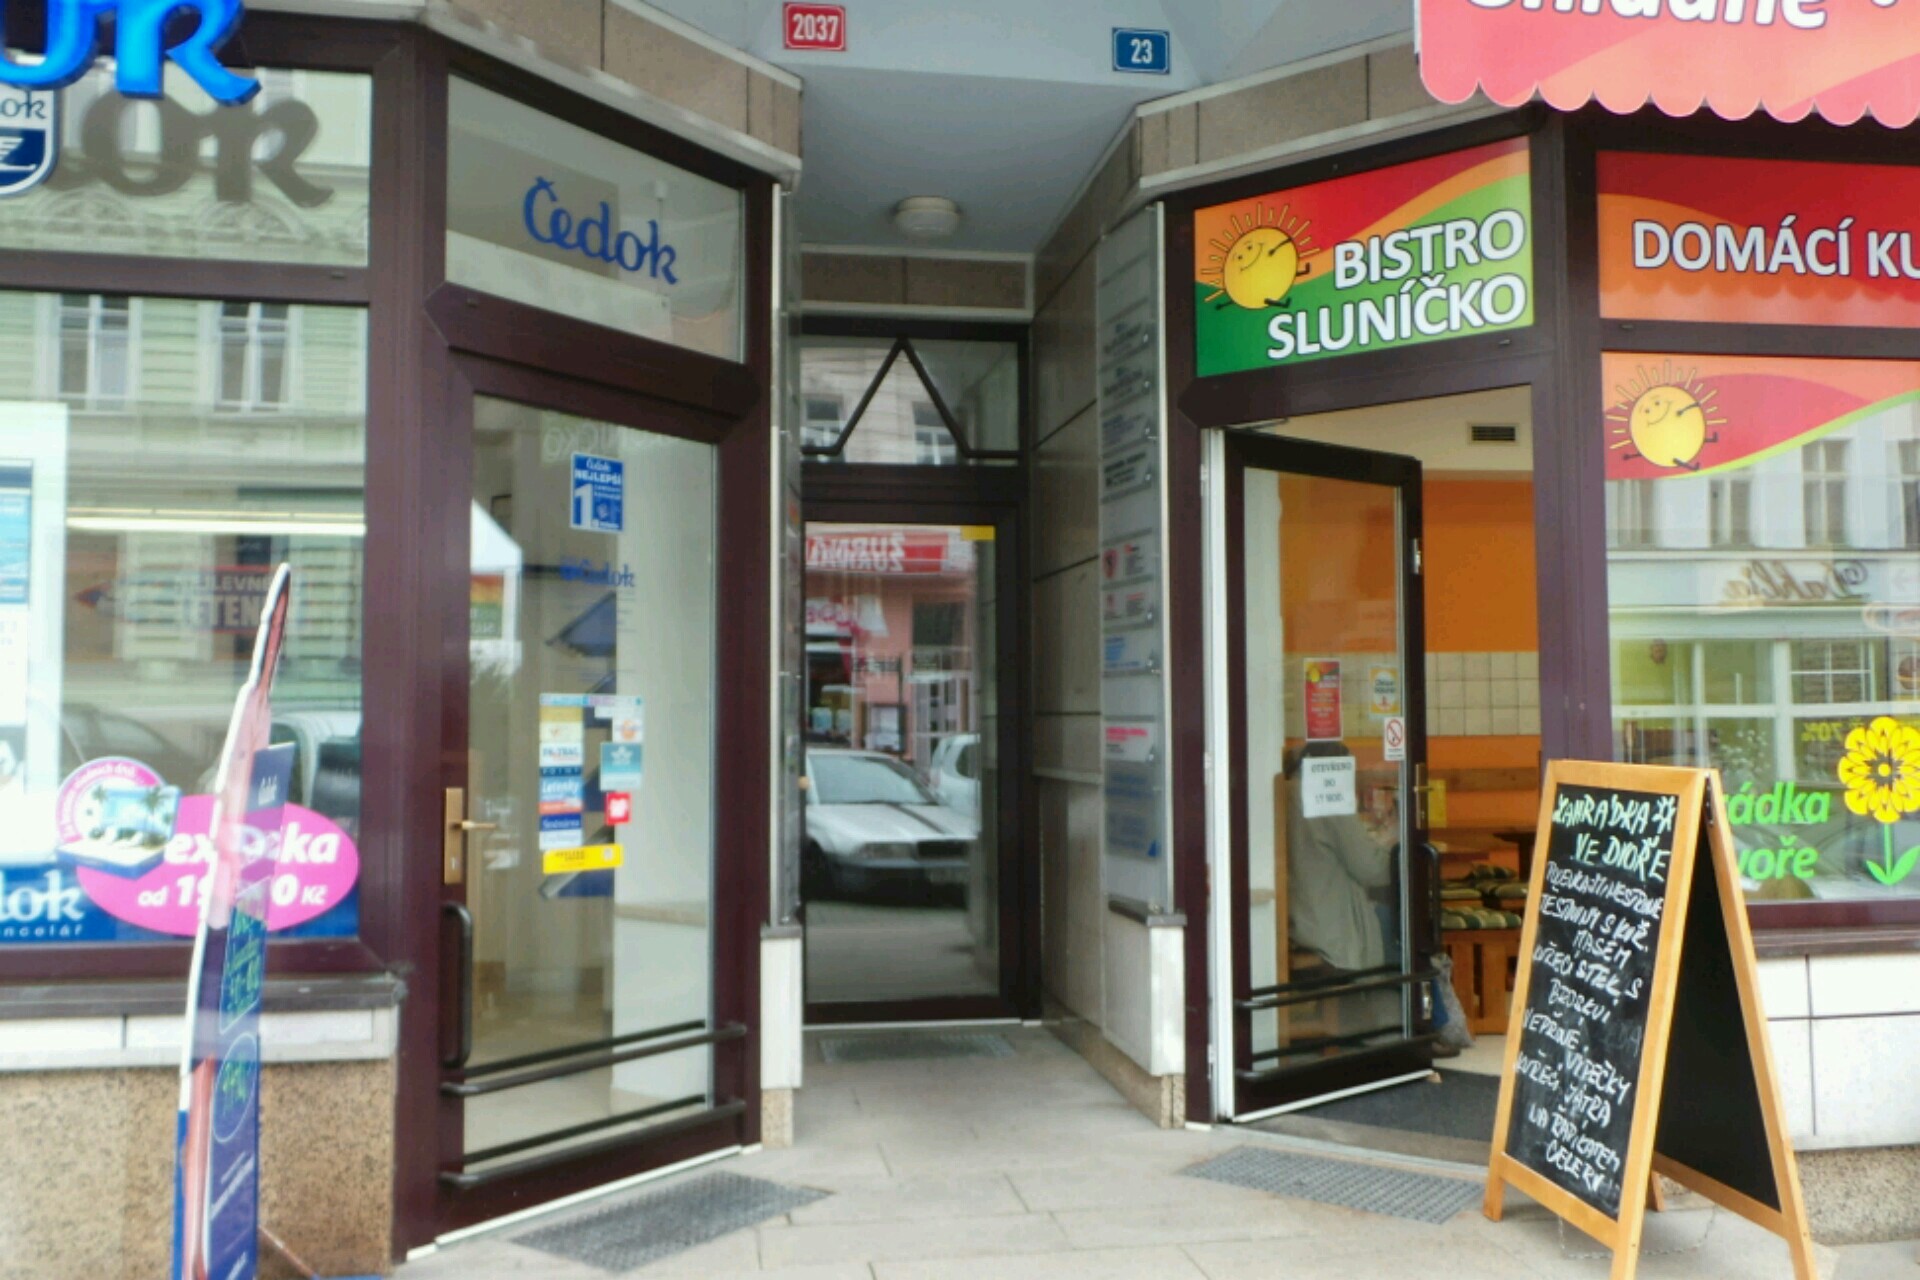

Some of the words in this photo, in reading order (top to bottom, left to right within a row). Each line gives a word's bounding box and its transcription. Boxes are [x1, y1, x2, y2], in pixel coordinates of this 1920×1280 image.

[793, 13, 839, 42] 2037
[1131, 37, 1153, 64] 23
[523, 176, 679, 285] Čedok
[1334, 208, 1526, 290] BISTRO
[1633, 214, 1854, 276] DOMÁCÍ
[1867, 230, 1920, 281] KU
[1267, 272, 1527, 360] SLUNÍČKO
[138, 886, 168, 907] od
[302, 885, 328, 905] Kč
